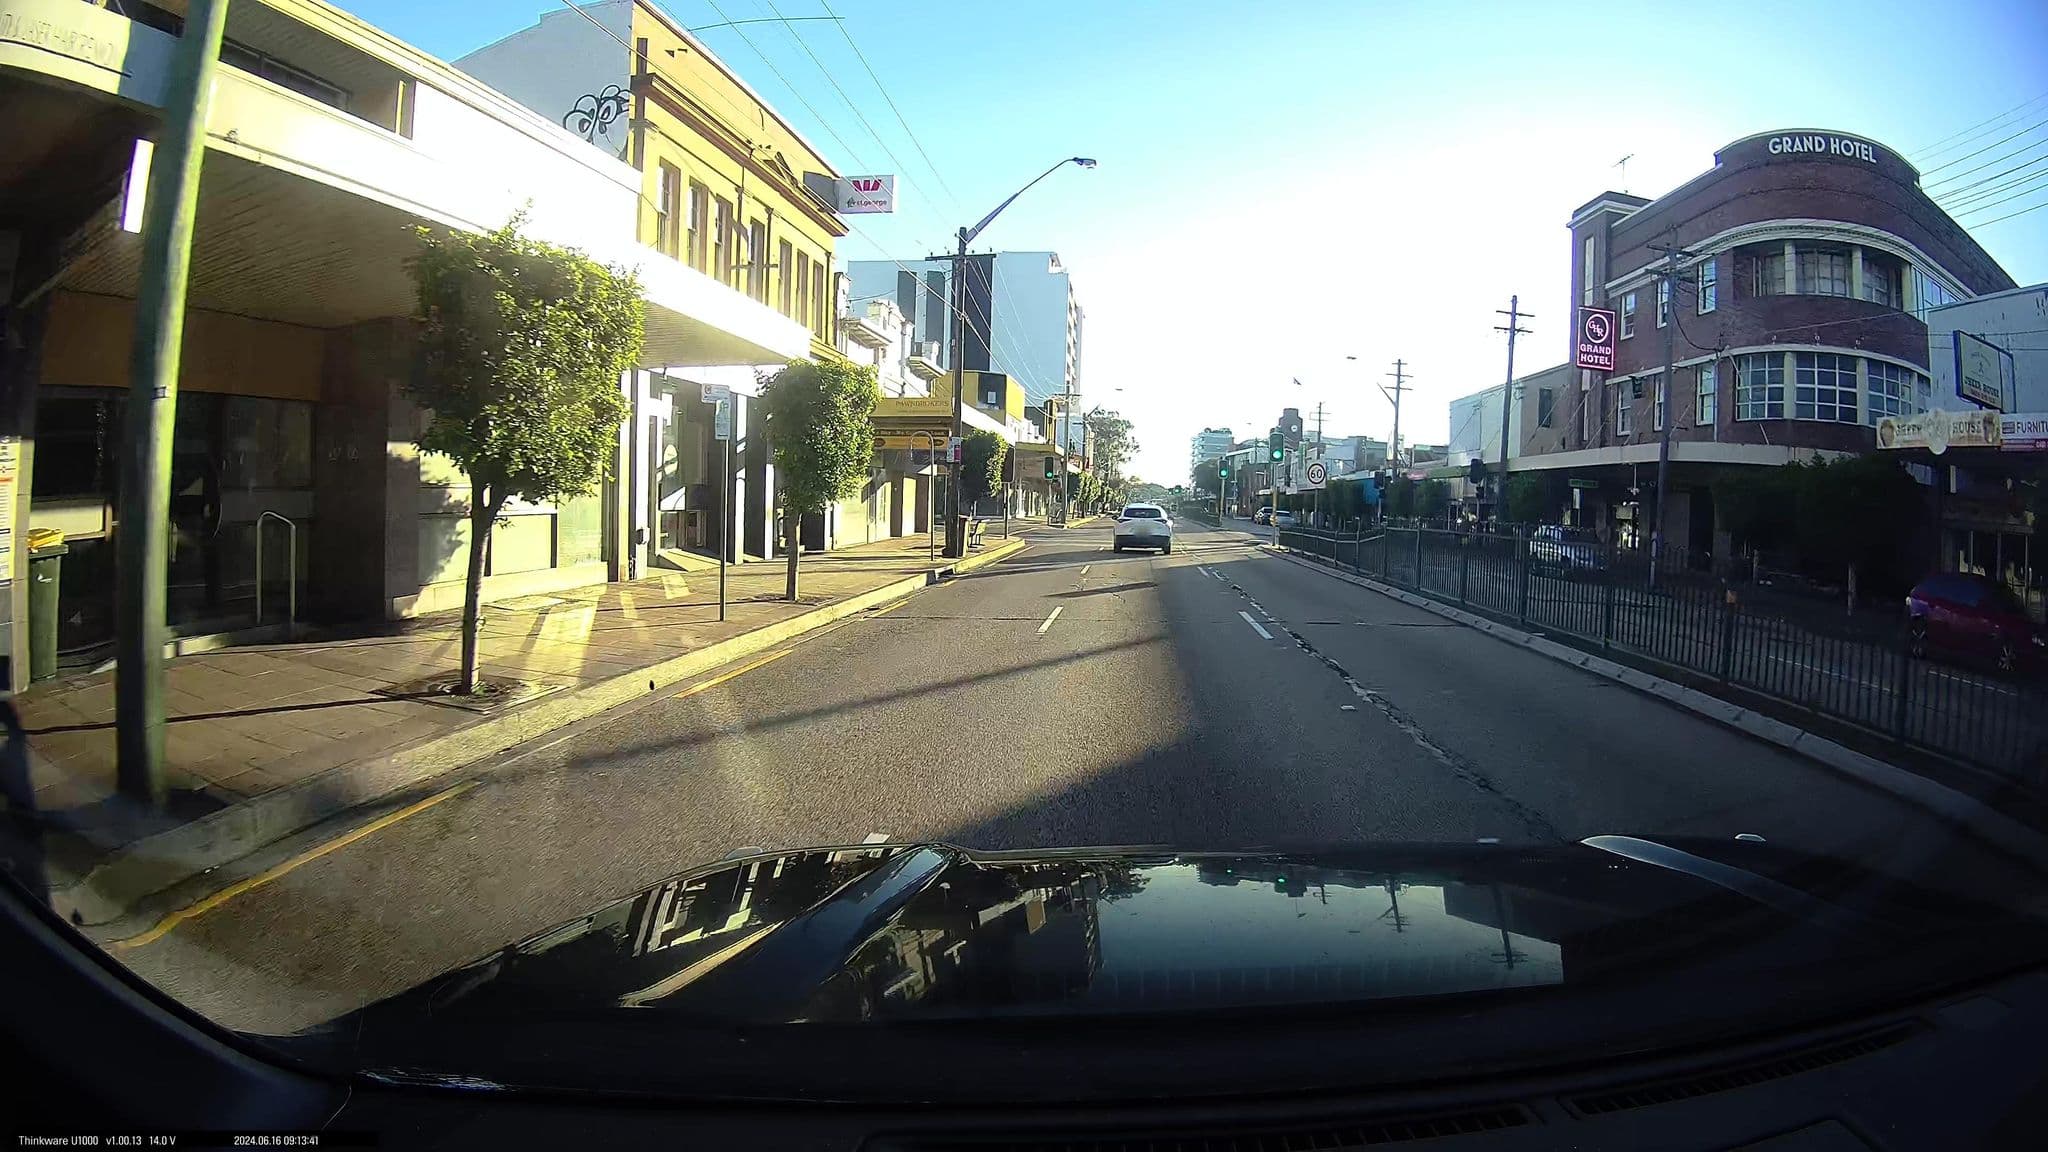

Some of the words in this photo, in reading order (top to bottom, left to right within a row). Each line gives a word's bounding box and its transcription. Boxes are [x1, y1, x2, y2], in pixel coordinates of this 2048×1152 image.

[1768, 136, 1826, 154] GRAND
[1830, 137, 1877, 163] HOTEL
[1588, 320, 1604, 337] GHR
[1580, 343, 1611, 355] GRAND
[1580, 353, 1611, 365] HOTEL
[1311, 469, 1323, 478] 60
